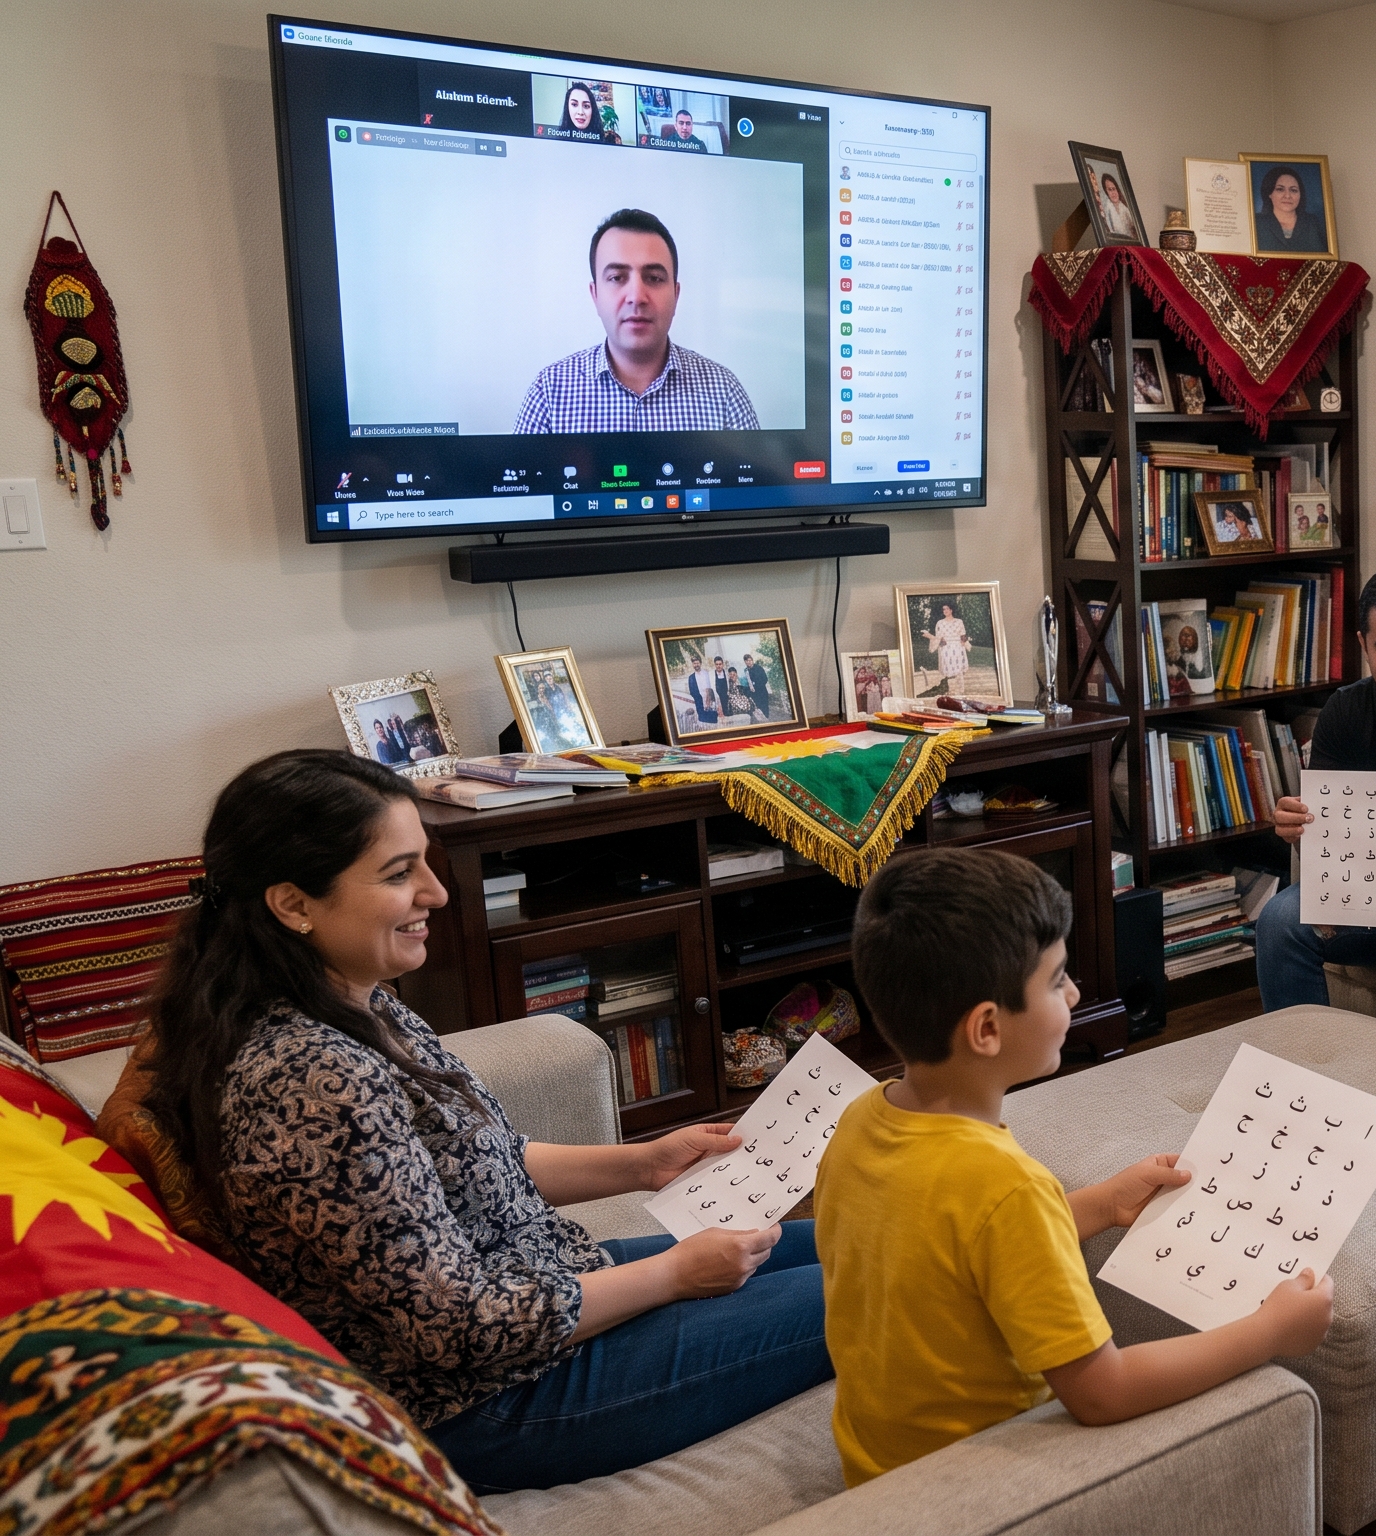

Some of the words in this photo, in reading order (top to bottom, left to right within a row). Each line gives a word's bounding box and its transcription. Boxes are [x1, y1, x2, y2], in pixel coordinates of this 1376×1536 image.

[375, 510, 394, 522] Type
[396, 510, 413, 519] here
[416, 510, 426, 518] to
[428, 508, 455, 518] search
[1365, 790, 1376, 800] ب
[1339, 851, 1355, 863] ص
[1341, 869, 1351, 883] ل
[1254, 1081, 1273, 1099] ث
[1289, 1095, 1307, 1113] ث
[1324, 1115, 1343, 1132] ب
[1200, 1176, 1218, 1195] ط
[1226, 1198, 1253, 1211] ص
[1265, 1206, 1284, 1226] ط
[1210, 1225, 1231, 1243] ل
[1291, 1226, 1319, 1242] ض
[1243, 1243, 1265, 1260] ك
[1277, 1257, 1299, 1275] ك
[1222, 1279, 1238, 1291] و
